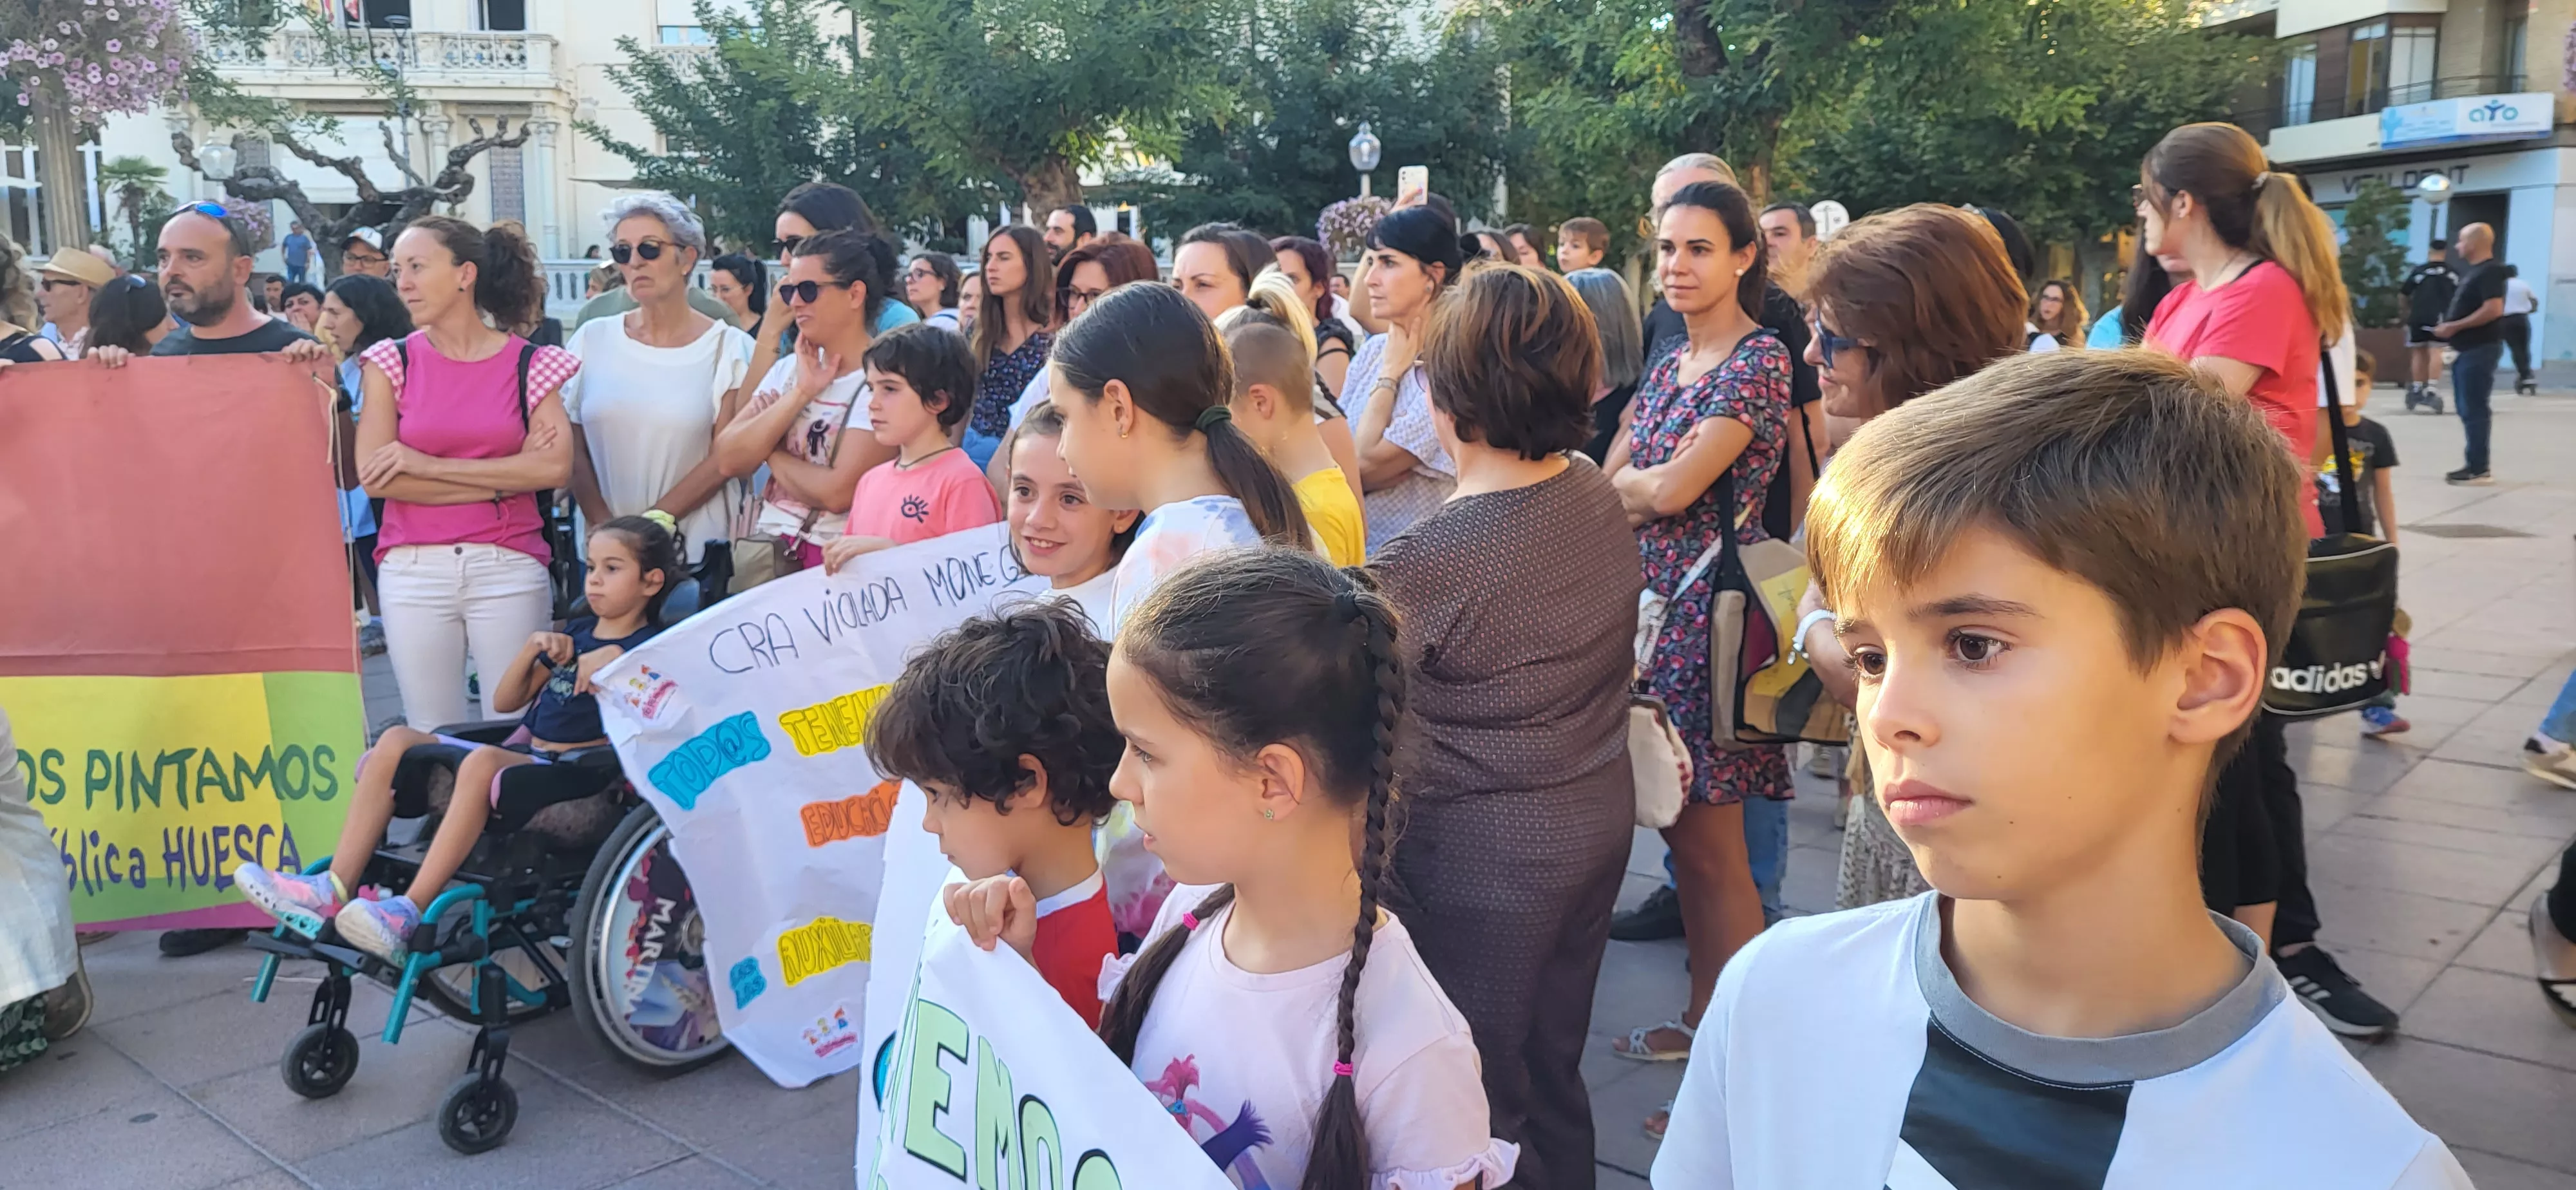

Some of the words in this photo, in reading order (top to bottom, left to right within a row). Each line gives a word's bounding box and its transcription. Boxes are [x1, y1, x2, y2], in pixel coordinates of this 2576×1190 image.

[709, 612, 799, 674] CRA
[2270, 661, 2368, 694] adidas
[86, 743, 338, 814] PINTAMOS
[648, 710, 772, 811] TOD@S
[162, 822, 301, 892] HUESCA
